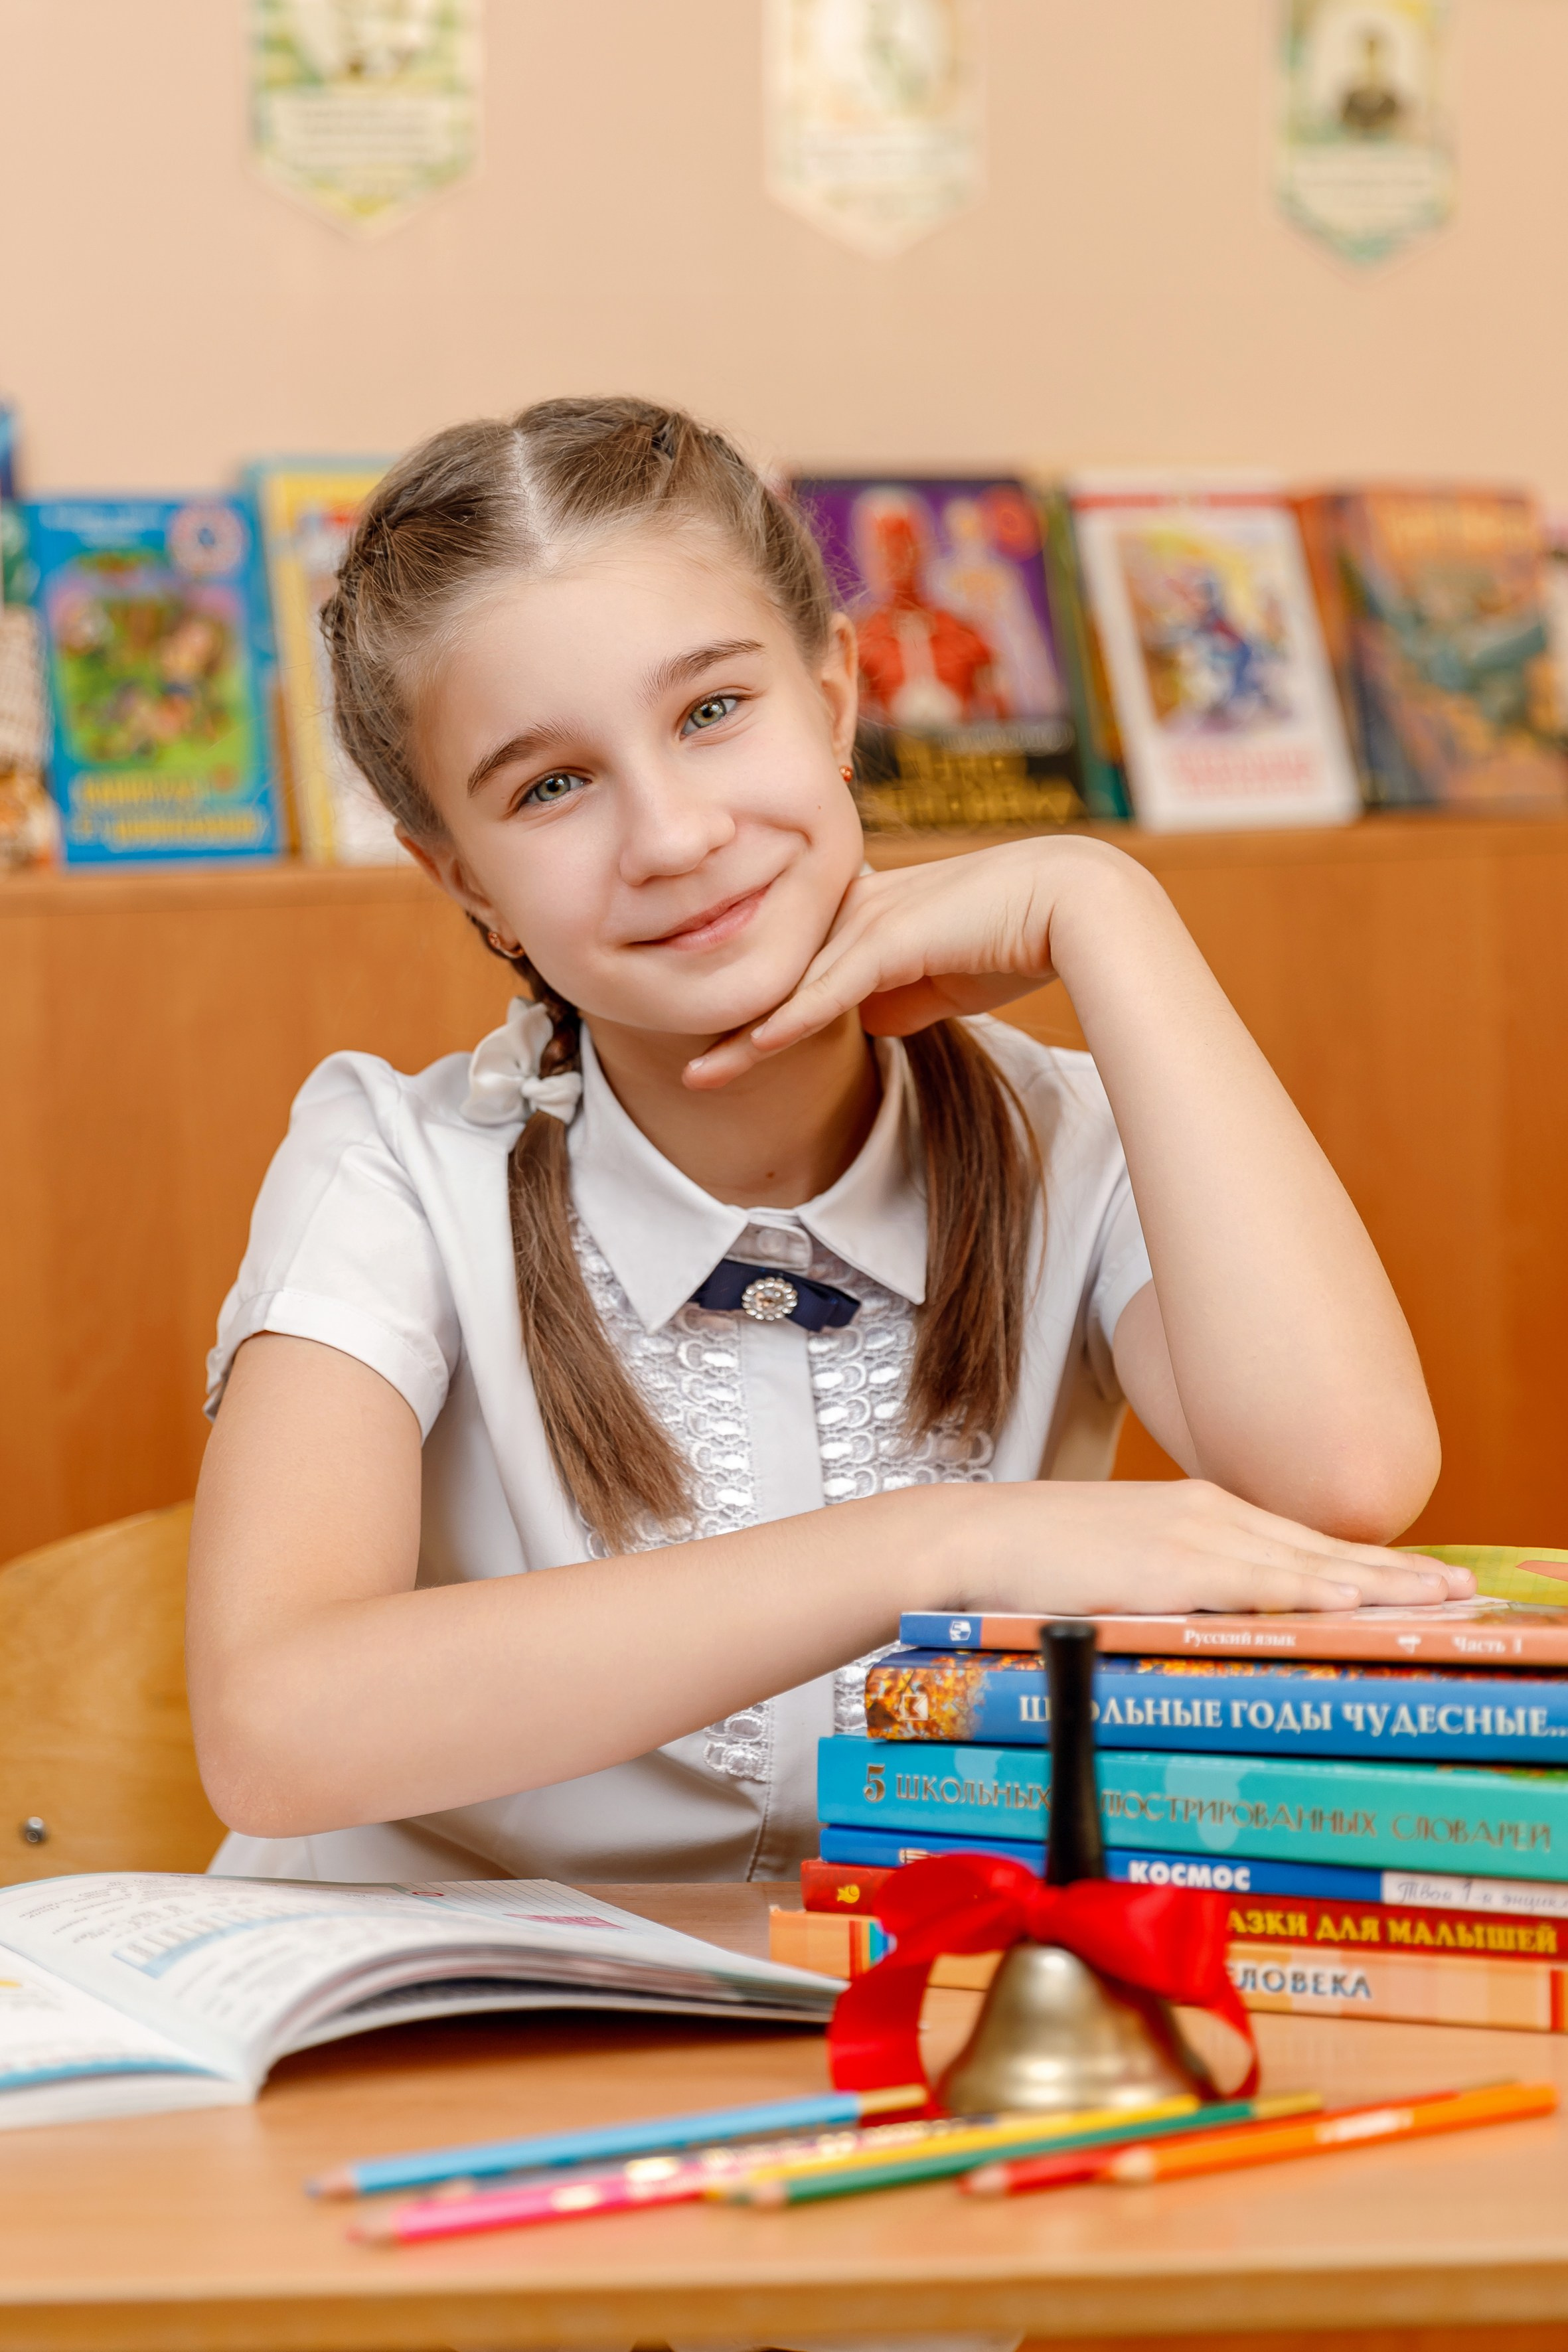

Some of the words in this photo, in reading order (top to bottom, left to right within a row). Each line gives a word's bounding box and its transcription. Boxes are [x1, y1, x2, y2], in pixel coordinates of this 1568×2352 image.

[1184, 1629, 1251, 1646] Русский
[1255, 1634, 1296, 1648] язык
[1452, 1636, 1506, 1653] Часть
[1019, 1695, 1223, 1727] ШЛЬНЫЕ
[1231, 1701, 1332, 1734] ГОДЫ
[863, 1764, 886, 1803] 5
[895, 1773, 1052, 1811] ШКОЛЬНЫХ
[1100, 1788, 1377, 1838] ЛЮСТРИРОВАННЫХ
[1391, 1812, 1551, 1853] СЛОВАРЕЙ
[1129, 1859, 1251, 1891] КОСМОС
[1397, 1880, 1452, 1904] Твоя
[1227, 1908, 1308, 1938] АЗКИ
[1315, 1915, 1381, 1942] ДЛЯ
[1387, 1917, 1559, 1954] МАЛЫШЕЙ
[1225, 1961, 1372, 1999] ЛОВЕКА
